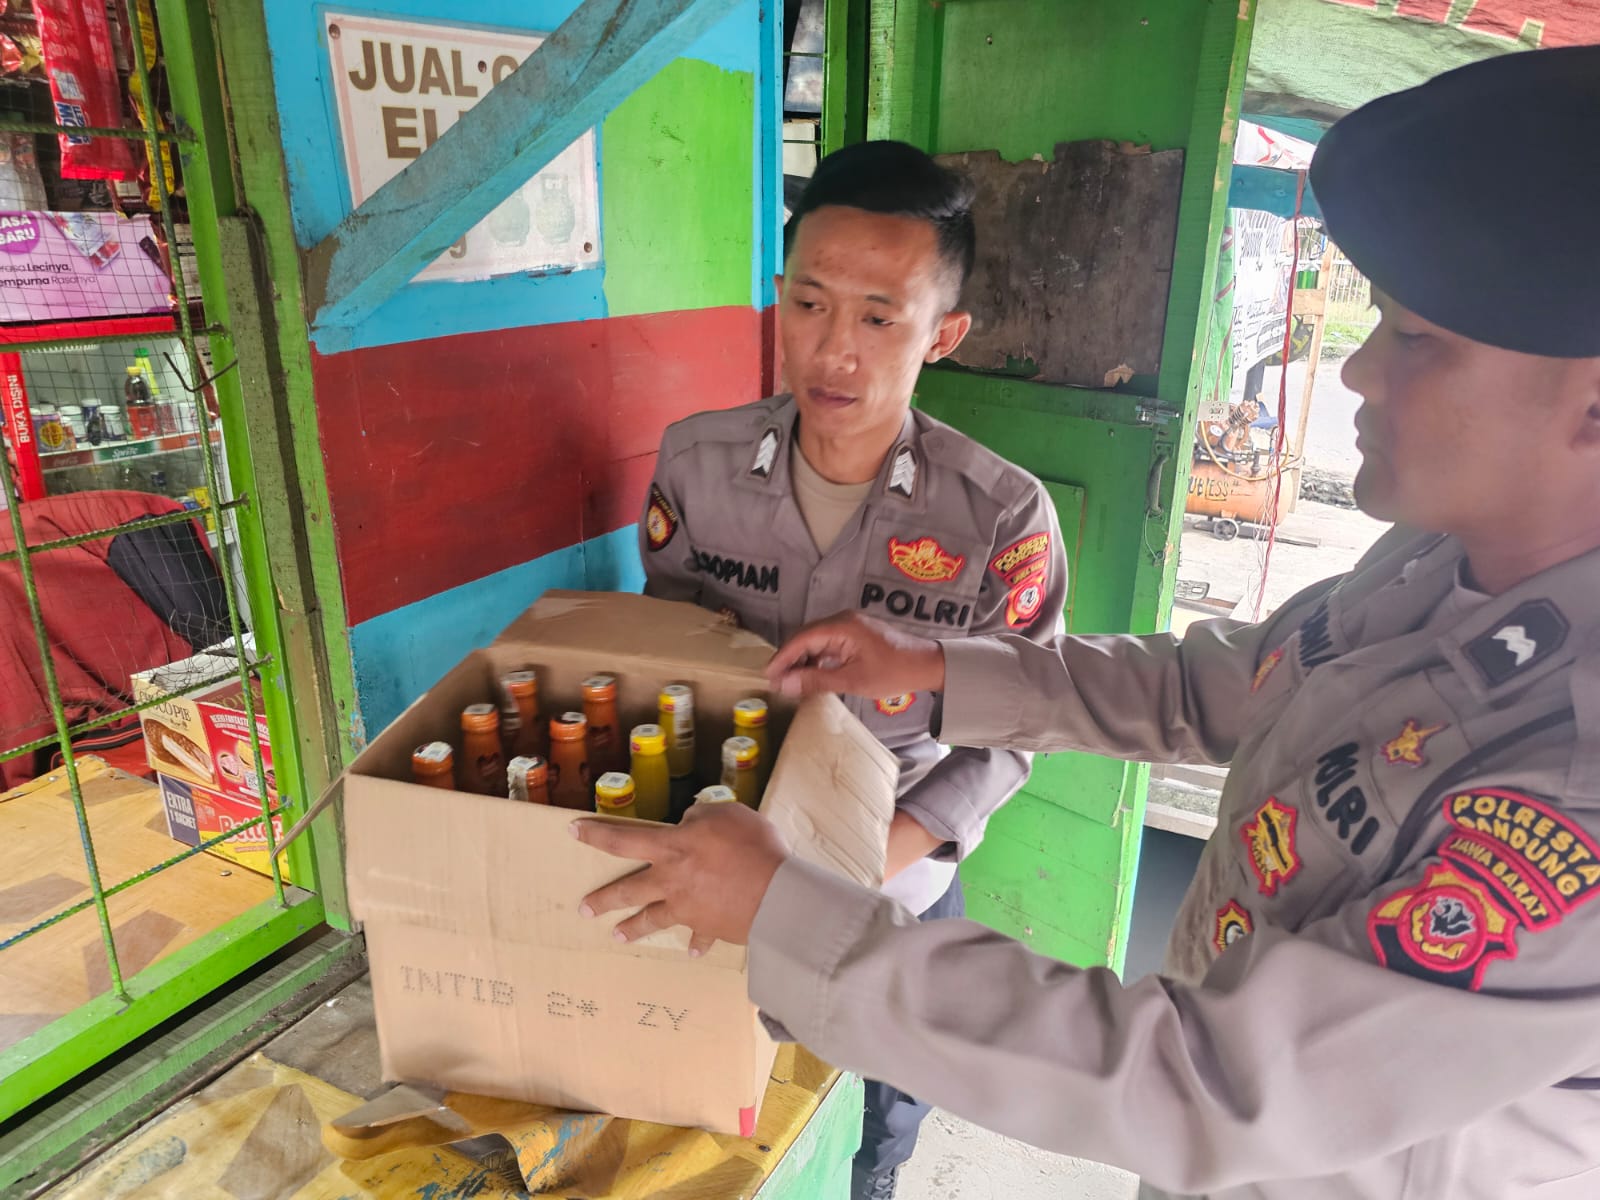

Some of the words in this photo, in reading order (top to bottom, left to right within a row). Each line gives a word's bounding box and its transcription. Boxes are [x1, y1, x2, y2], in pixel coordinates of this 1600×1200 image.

[349, 40, 478, 98] JUAL
[0, 277, 50, 288] empurna
[8, 374, 23, 409] DISINI
[15, 411, 30, 444] BUKA
[112, 447, 139, 459] Sprite
[861, 583, 970, 627] POLRI
[166, 791, 194, 816] EXTRA
[1453, 795, 1600, 885] POLRESTA
[1450, 838, 1493, 866] JAWA
[1492, 861, 1548, 917] BARAT
[636, 1001, 690, 1031] ZY
